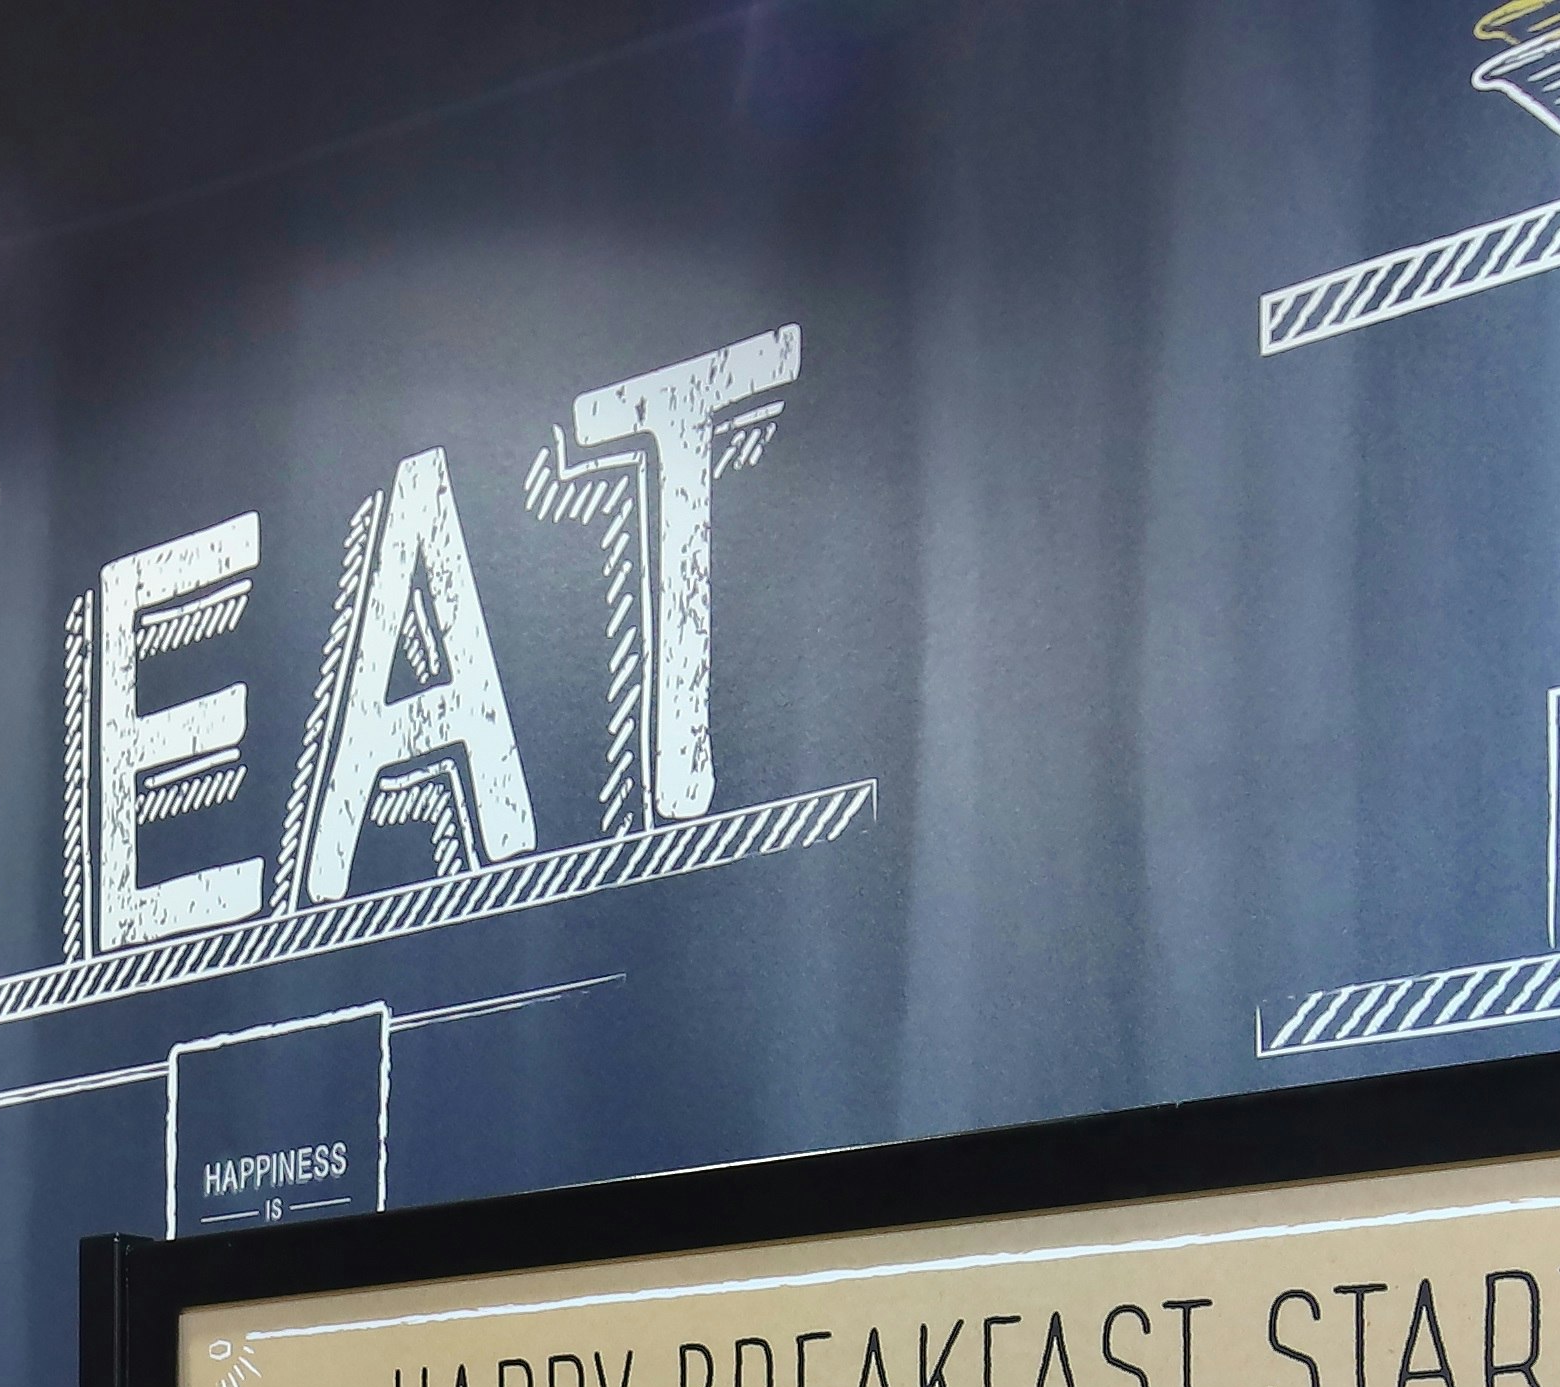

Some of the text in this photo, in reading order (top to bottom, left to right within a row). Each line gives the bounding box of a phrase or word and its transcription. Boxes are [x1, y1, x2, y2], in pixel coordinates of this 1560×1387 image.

[66, 323, 801, 962] EAT
[204, 1141, 349, 1197] HAPPINESS
[265, 1198, 282, 1221] IS
